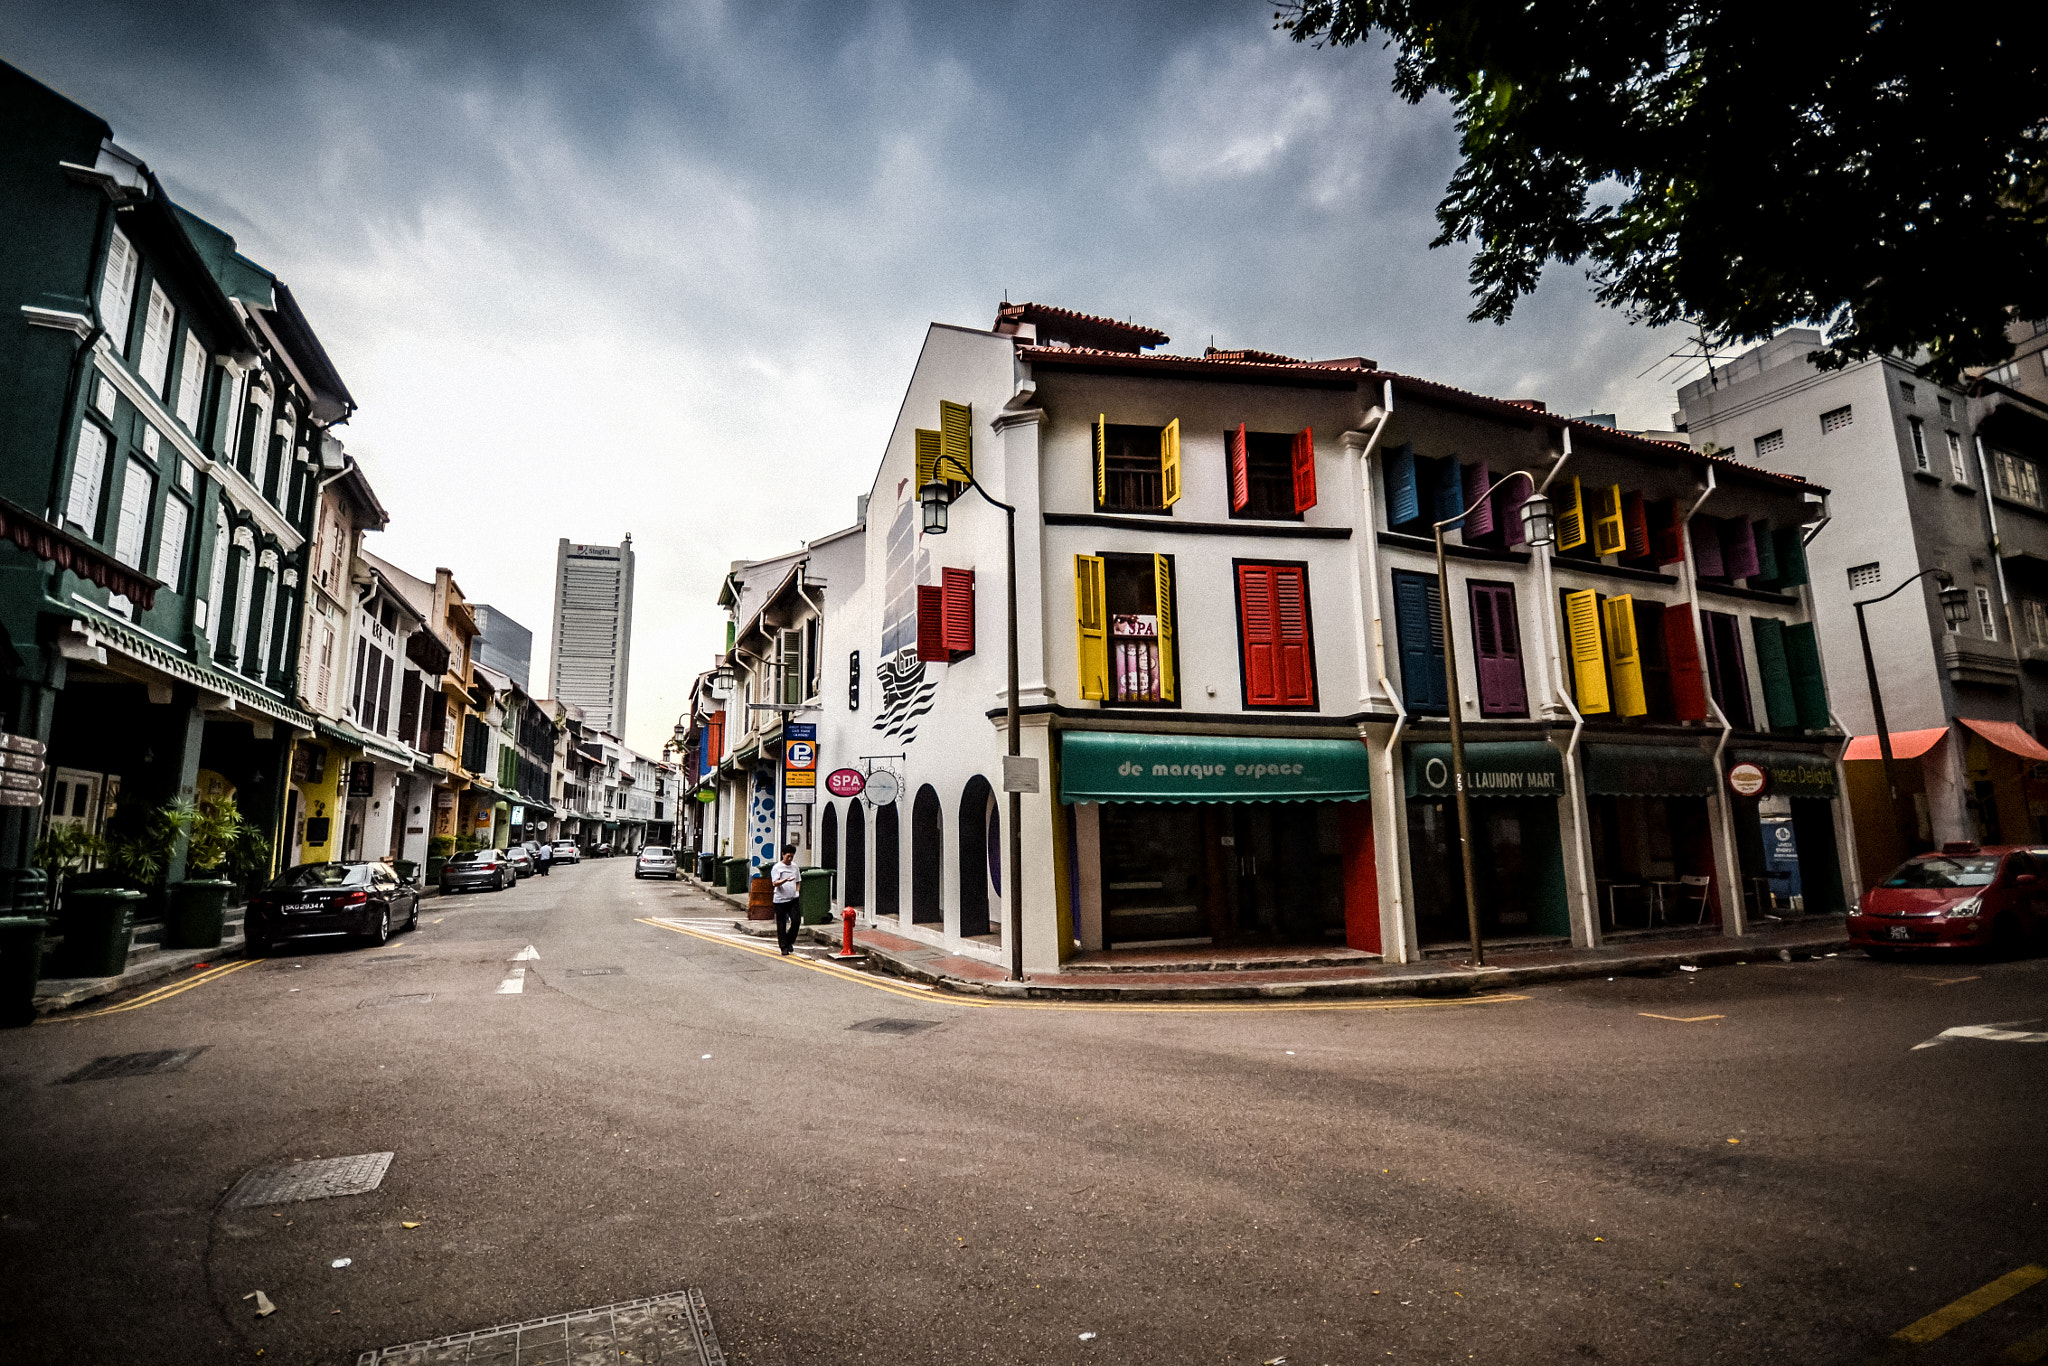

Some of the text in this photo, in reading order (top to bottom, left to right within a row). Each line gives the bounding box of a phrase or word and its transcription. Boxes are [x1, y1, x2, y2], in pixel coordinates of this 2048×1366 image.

[1128, 622, 1154, 635] SPA
[1118, 760, 1304, 780] de marque espace
[1797, 765, 1834, 789] Delight
[832, 774, 860, 787] SPA
[1475, 772, 1524, 789] LAUNDRY
[1527, 772, 1555, 788] MART
[314, 799, 326, 810] 70
